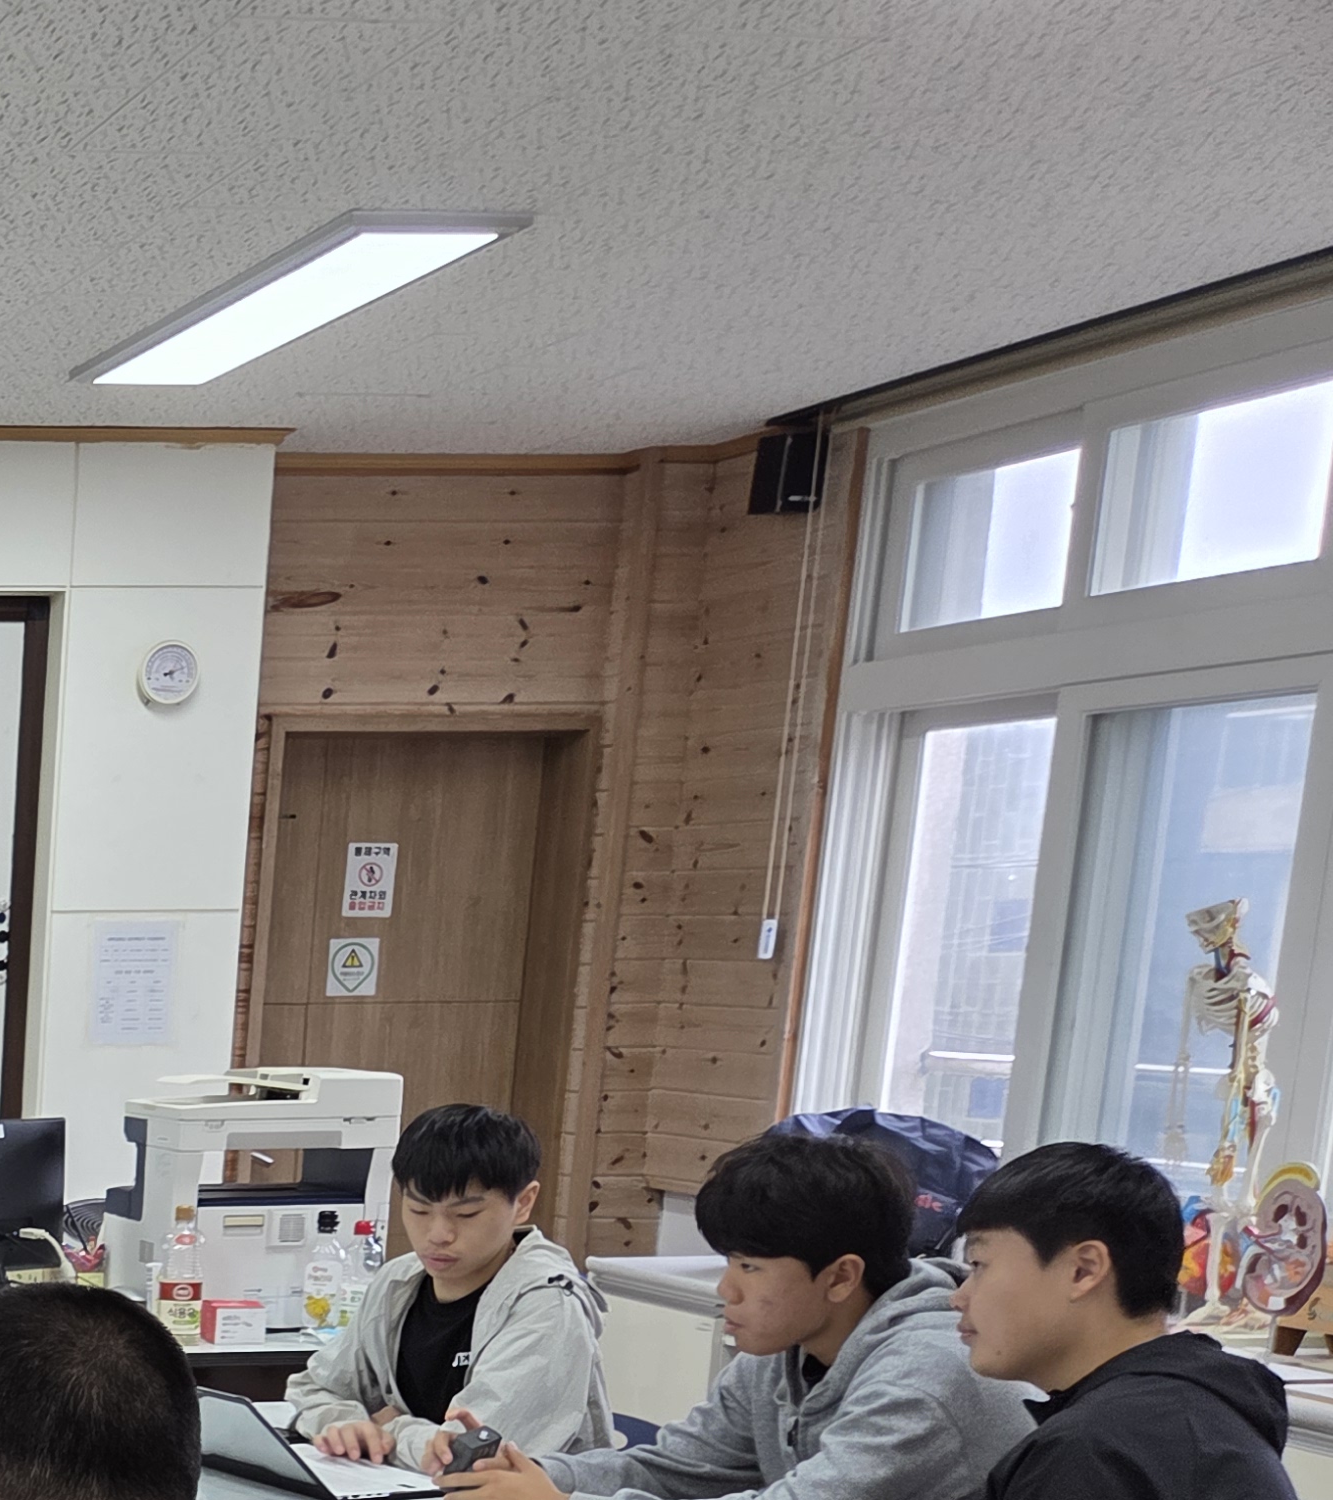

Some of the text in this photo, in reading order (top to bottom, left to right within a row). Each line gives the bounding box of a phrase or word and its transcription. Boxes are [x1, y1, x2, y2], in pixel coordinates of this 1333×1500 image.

[354, 846, 391, 857] 통제구역
[349, 890, 387, 900] 관계자외
[348, 901, 385, 911] 출입금지
